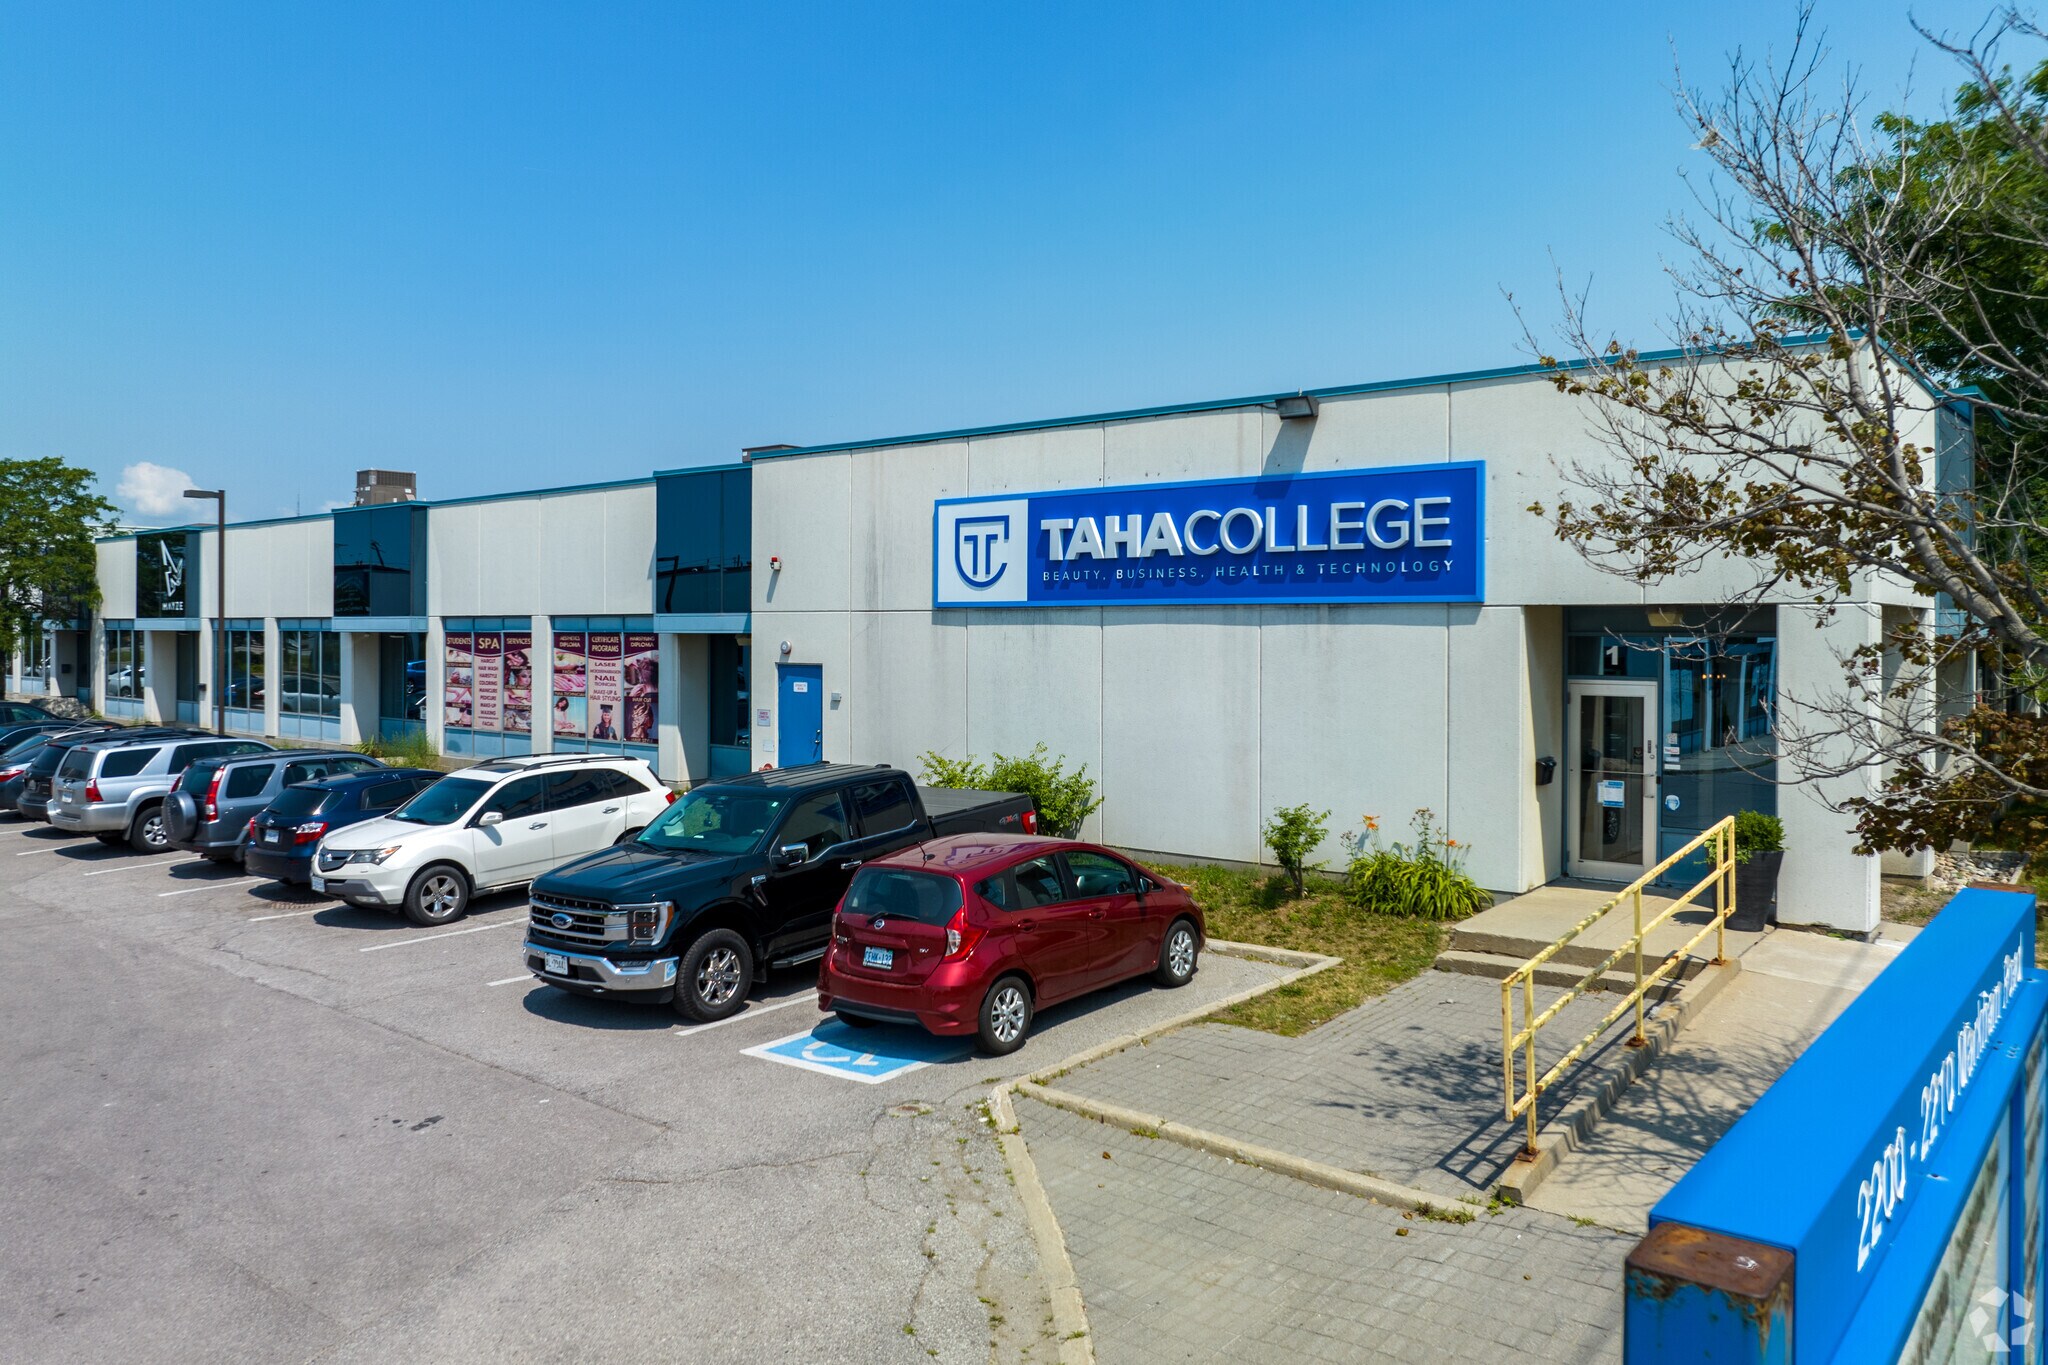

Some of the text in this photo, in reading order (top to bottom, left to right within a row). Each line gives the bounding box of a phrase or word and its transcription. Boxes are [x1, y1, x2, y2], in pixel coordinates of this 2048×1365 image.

[1043, 559, 1453, 582] BEAUTY, BUSINESS, HEALTH & TECHNOLOGY
[478, 637, 500, 649] SPA
[1606, 645, 1619, 666] 1
[1857, 1126, 1906, 1272] 2200
